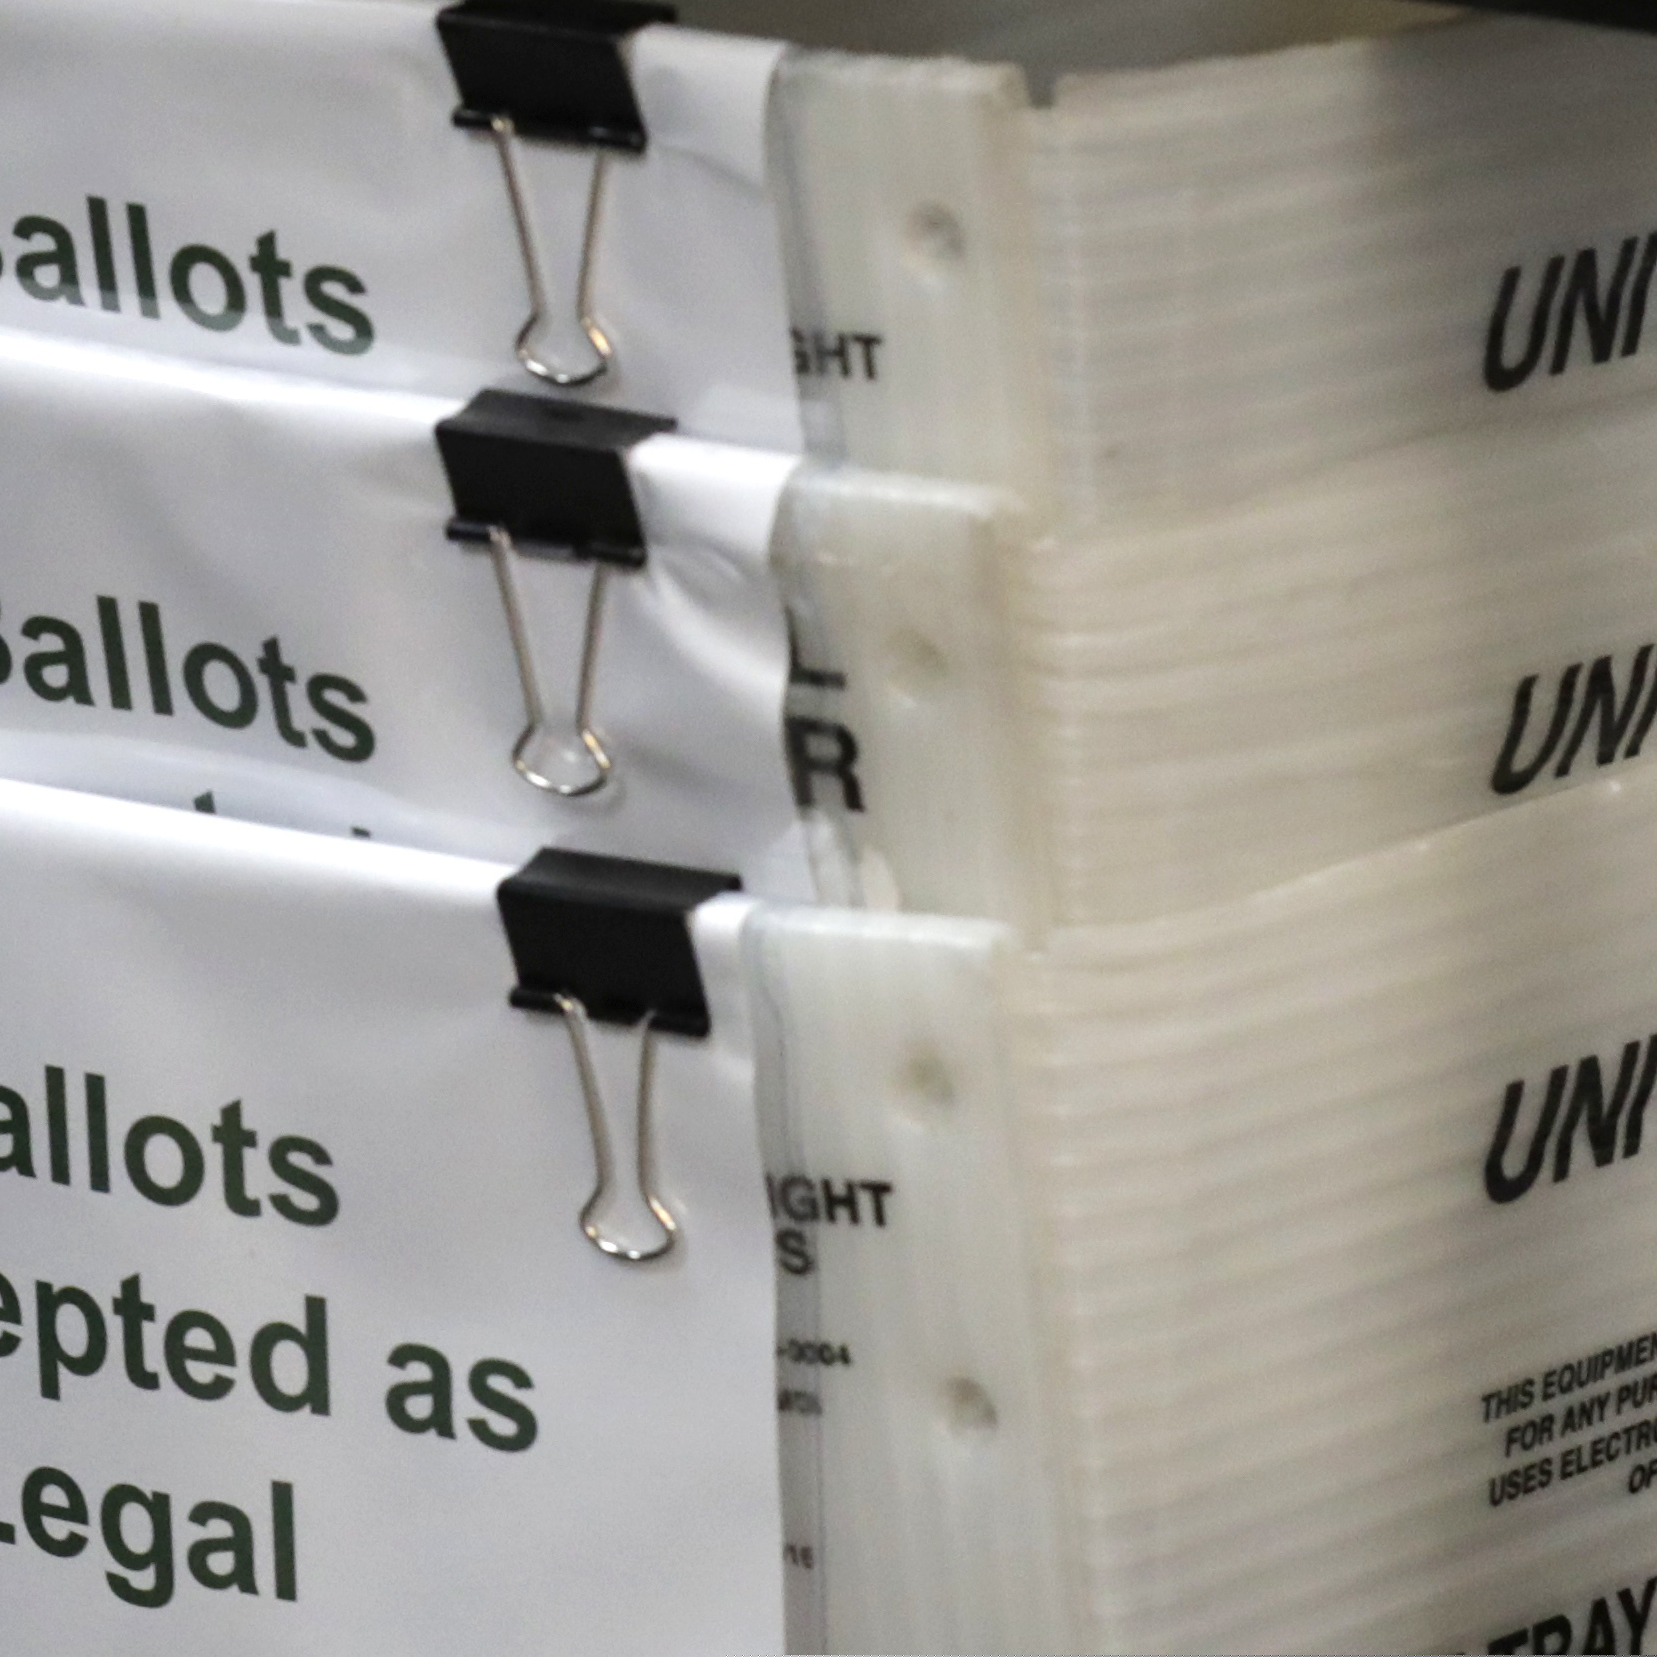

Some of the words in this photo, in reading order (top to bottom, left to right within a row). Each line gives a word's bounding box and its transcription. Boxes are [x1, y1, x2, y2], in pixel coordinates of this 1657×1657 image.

[1482, 230, 1657, 395] UNI
[1489, 642, 1657, 797] UNI
[1483, 1031, 1657, 1207] UNI
[384, 1342, 539, 1454] as
[1480, 1375, 1537, 1425] THIS
[1503, 1411, 1556, 1459] FOR
[1559, 1389, 1613, 1439] ANY
[1487, 1454, 1555, 1509] USES
[1559, 1415, 1657, 1482] ELECTR
